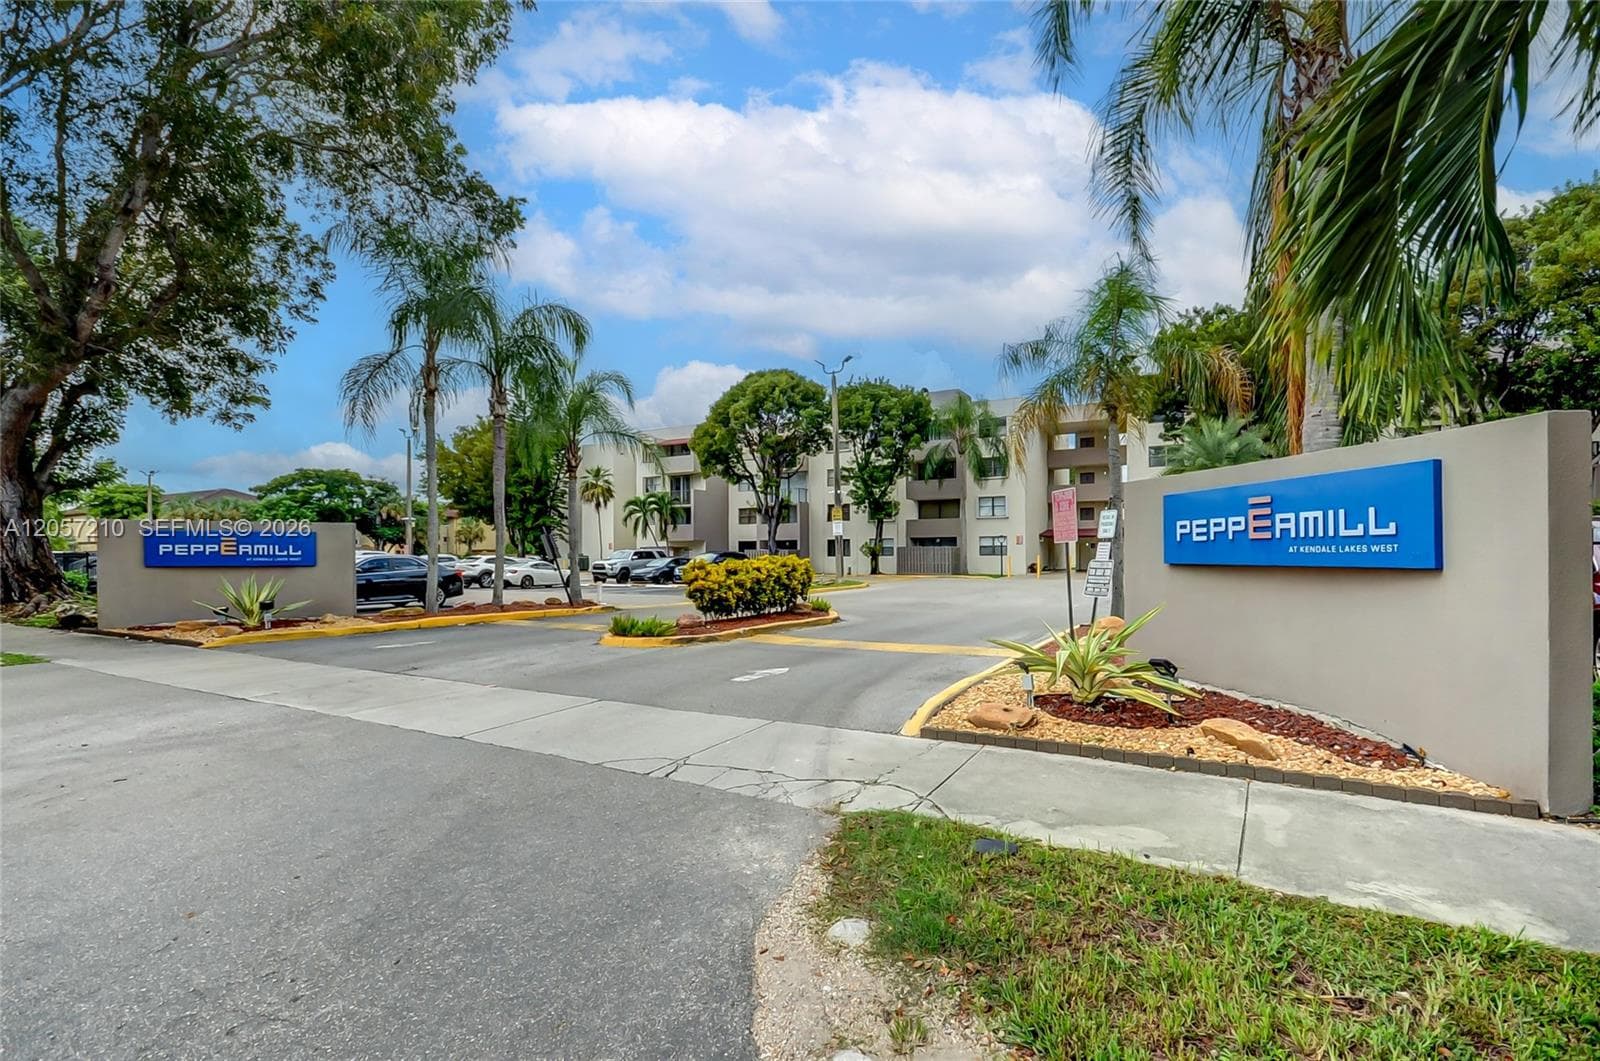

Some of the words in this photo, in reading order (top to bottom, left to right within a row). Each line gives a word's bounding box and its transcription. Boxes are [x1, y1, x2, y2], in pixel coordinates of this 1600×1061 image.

[1176, 495, 1397, 542] PEPPERMILL
[158, 537, 302, 556] PEPPERMILL
[1300, 545, 1337, 553] KENDALE
[1339, 544, 1368, 553] LAKES
[1370, 543, 1399, 553] WEST
